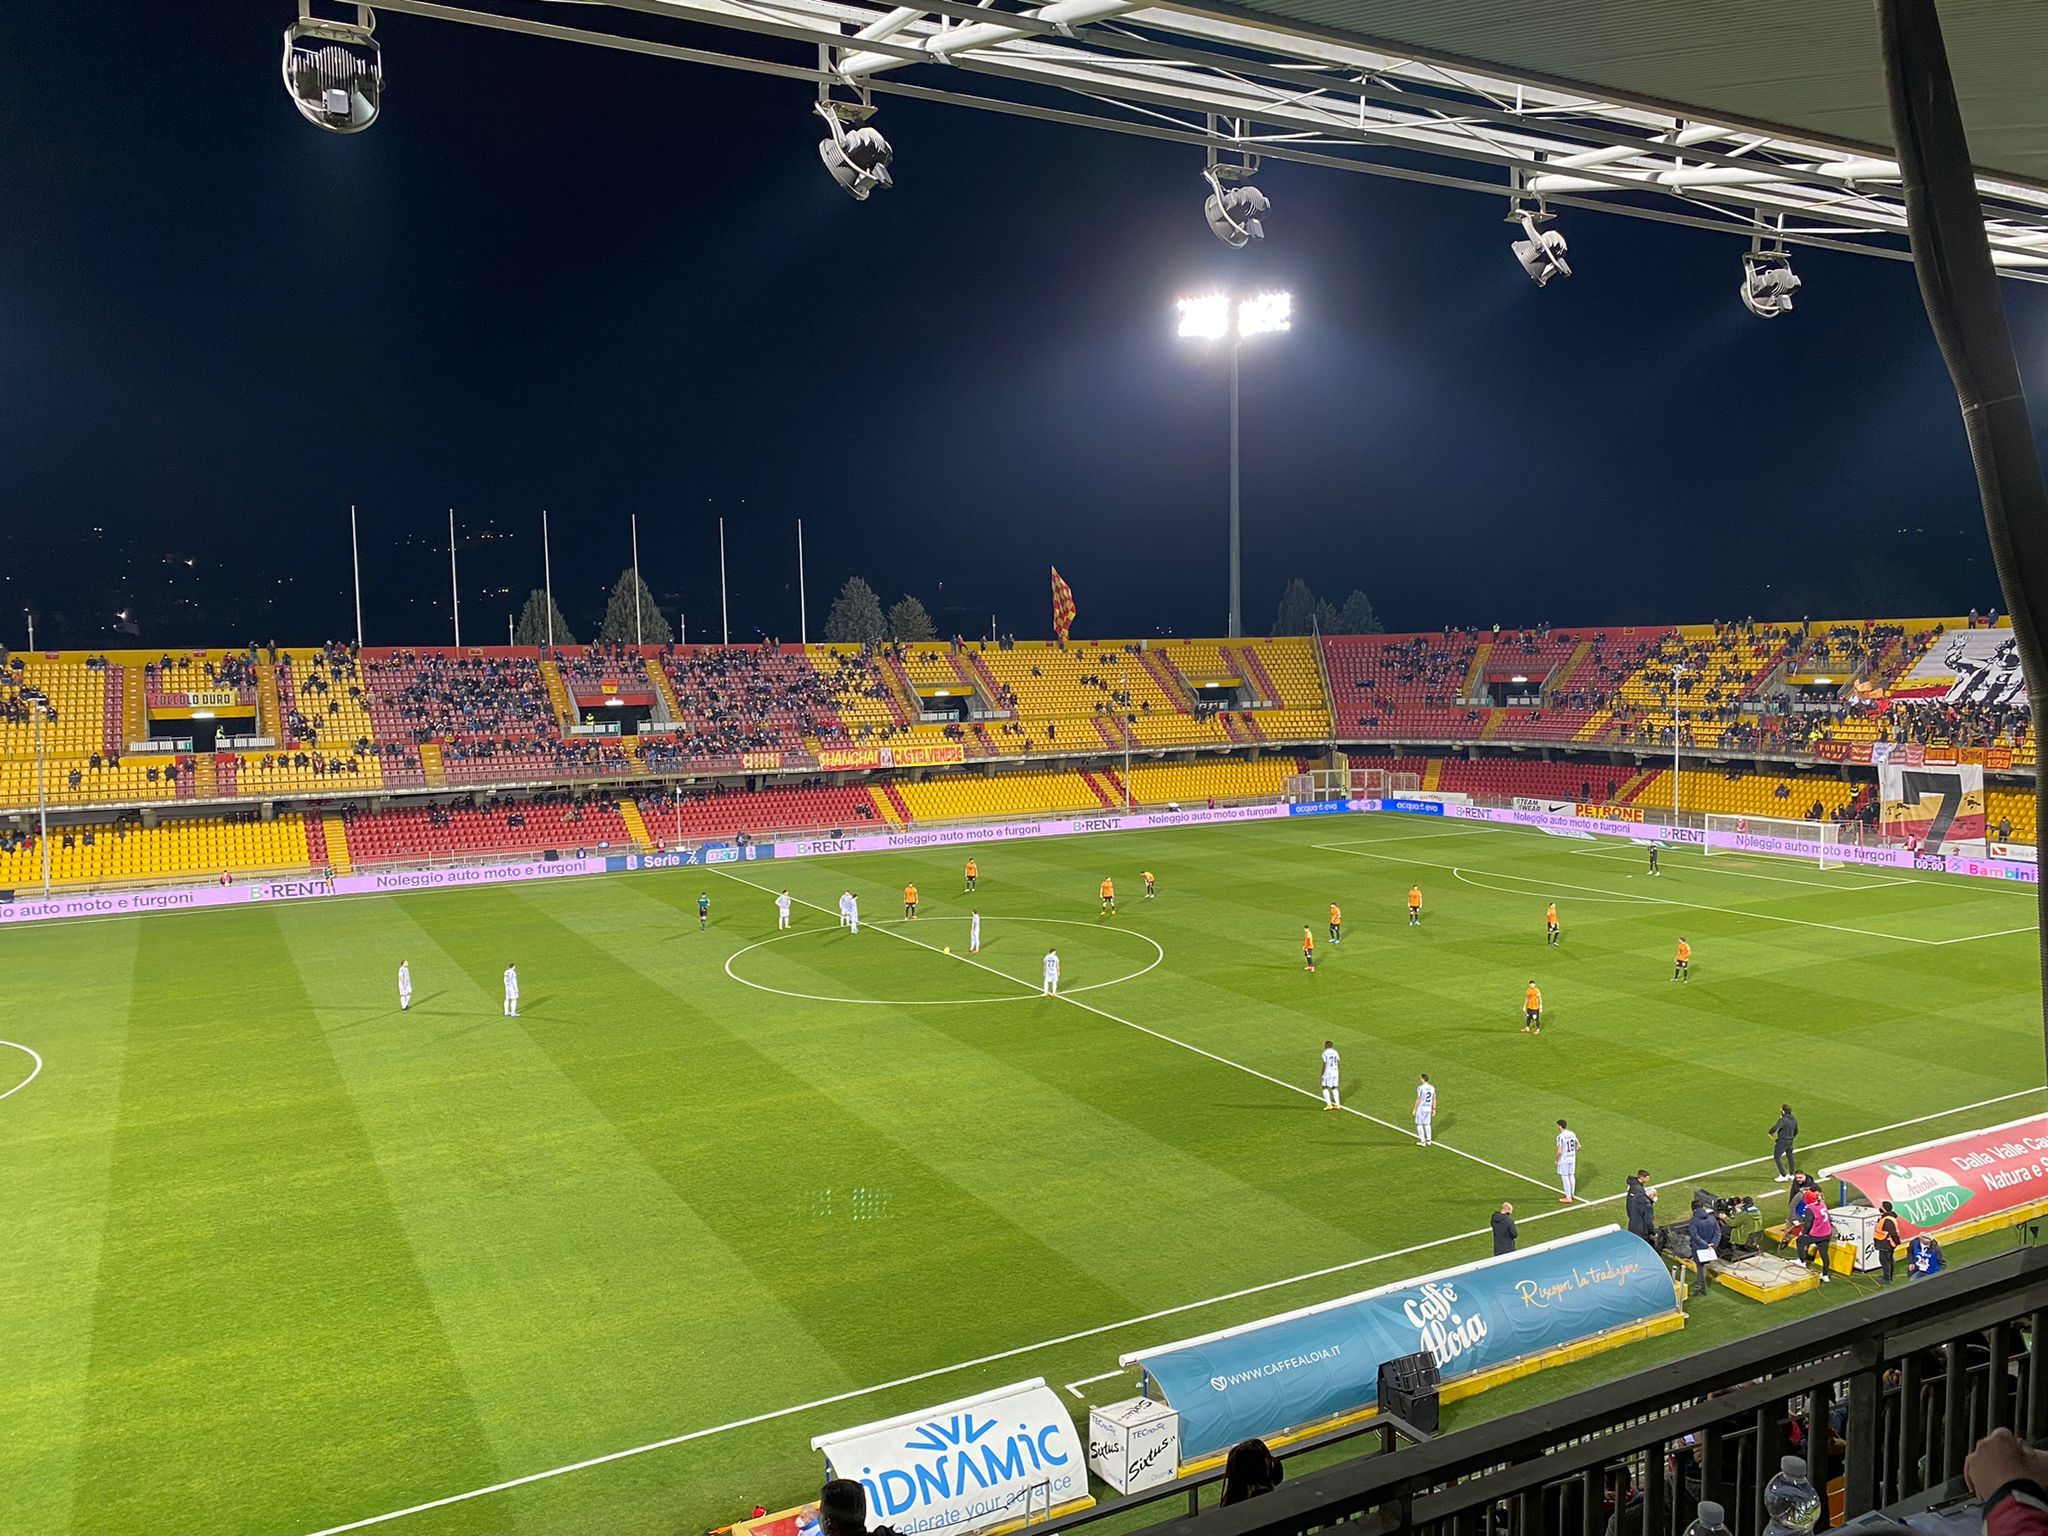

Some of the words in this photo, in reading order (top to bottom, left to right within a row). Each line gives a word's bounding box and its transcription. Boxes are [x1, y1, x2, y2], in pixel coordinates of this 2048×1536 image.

[154, 695, 199, 705] ZOCCOLO
[202, 694, 230, 704] DURO
[819, 749, 878, 768] SHANGHAI
[1148, 810, 1190, 825] Noleggio
[1192, 809, 1212, 821] auto
[1214, 807, 1238, 819] moto
[1246, 806, 1277, 819] furgoni
[1513, 811, 1548, 825] Noleggio
[1550, 816, 1568, 826] auto
[1569, 819, 1591, 829] moto
[1600, 821, 1631, 834] furgoni
[1576, 804, 1643, 823] PETRONE
[888, 831, 937, 847] Noleggio
[940, 828, 963, 842] auto
[966, 826, 994, 840] moto
[996, 828, 1003, 837] e
[1005, 823, 1041, 838] furgoni
[708, 850, 737, 861] BKT
[1736, 834, 1782, 851] Noleggio
[1784, 840, 1809, 854] auto
[1844, 848, 1851, 857] e
[1854, 846, 1896, 862] furgoni
[644, 854, 680, 867] Serie
[1916, 860, 1944, 872] 00:00
[376, 870, 443, 891] Noleggio
[448, 868, 479, 882] auto
[484, 865, 521, 879] moto
[525, 866, 534, 876] e
[537, 859, 587, 876] furgoni
[1969, 864, 2036, 883] Bambini
[20, 902, 60, 916] auto
[66, 897, 112, 913] moto
[118, 898, 128, 909] e
[132, 890, 194, 909] furgoni
[1425, 1091, 1432, 1103] 2
[1951, 1152, 1995, 1171] Dalla
[1991, 1142, 2029, 1160] Valle
[1981, 1169, 2032, 1191] Natura
[2032, 1163, 2043, 1177] e
[1820, 1208, 1828, 1222] 5
[1904, 1191, 1960, 1225] MAURO
[1573, 1268, 1589, 1288] la
[1227, 1344, 1341, 1385] WWW.CAFFEALOIA.IT
[1090, 1442, 1120, 1460] Sixtus
[1129, 1438, 1169, 1482] Sixtus
[965, 1496, 1001, 1520] your
[1007, 1475, 1072, 1506] adance
